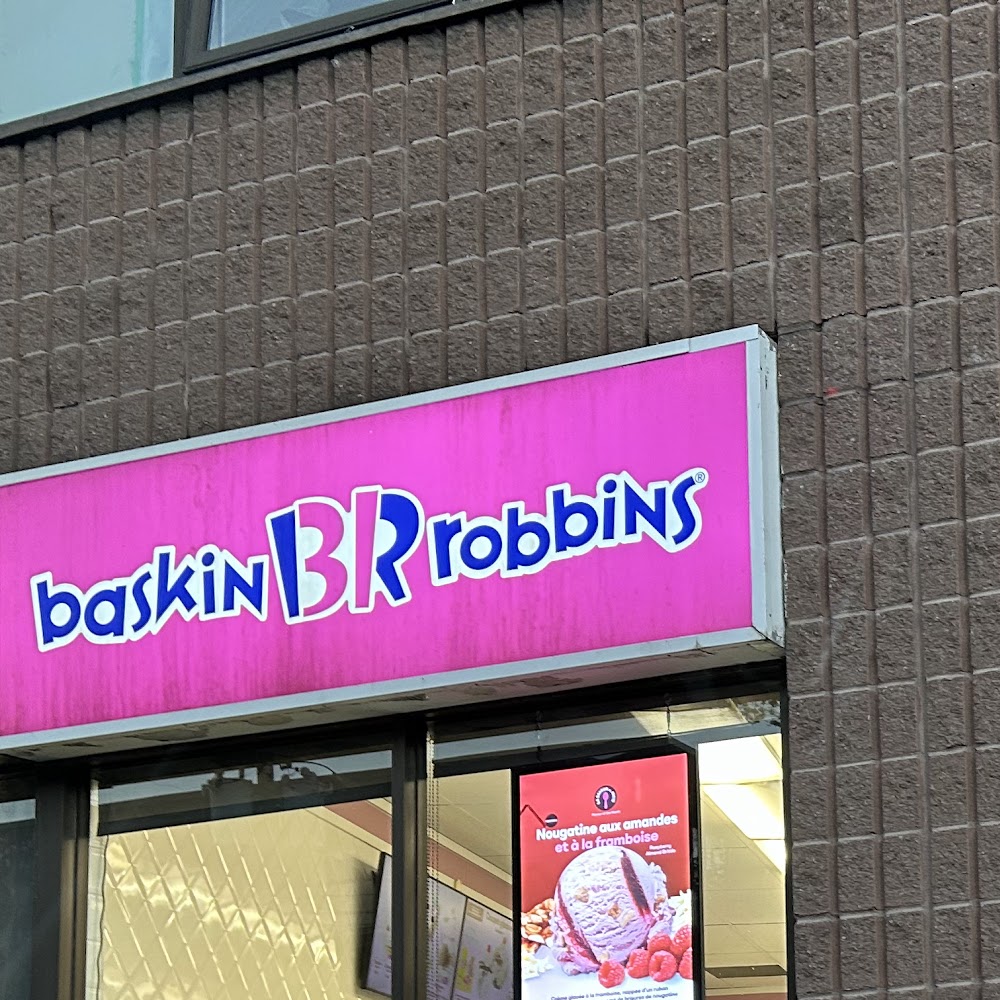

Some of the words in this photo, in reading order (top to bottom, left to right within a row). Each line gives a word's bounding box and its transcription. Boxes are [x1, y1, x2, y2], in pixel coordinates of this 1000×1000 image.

[536, 823, 598, 840] Nougatine
[599, 820, 621, 833] aux
[622, 813, 678, 830] amandes
[554, 841, 568, 853] et
[570, 839, 580, 851] à
[581, 837, 593, 850] la
[596, 830, 659, 848] framboise
